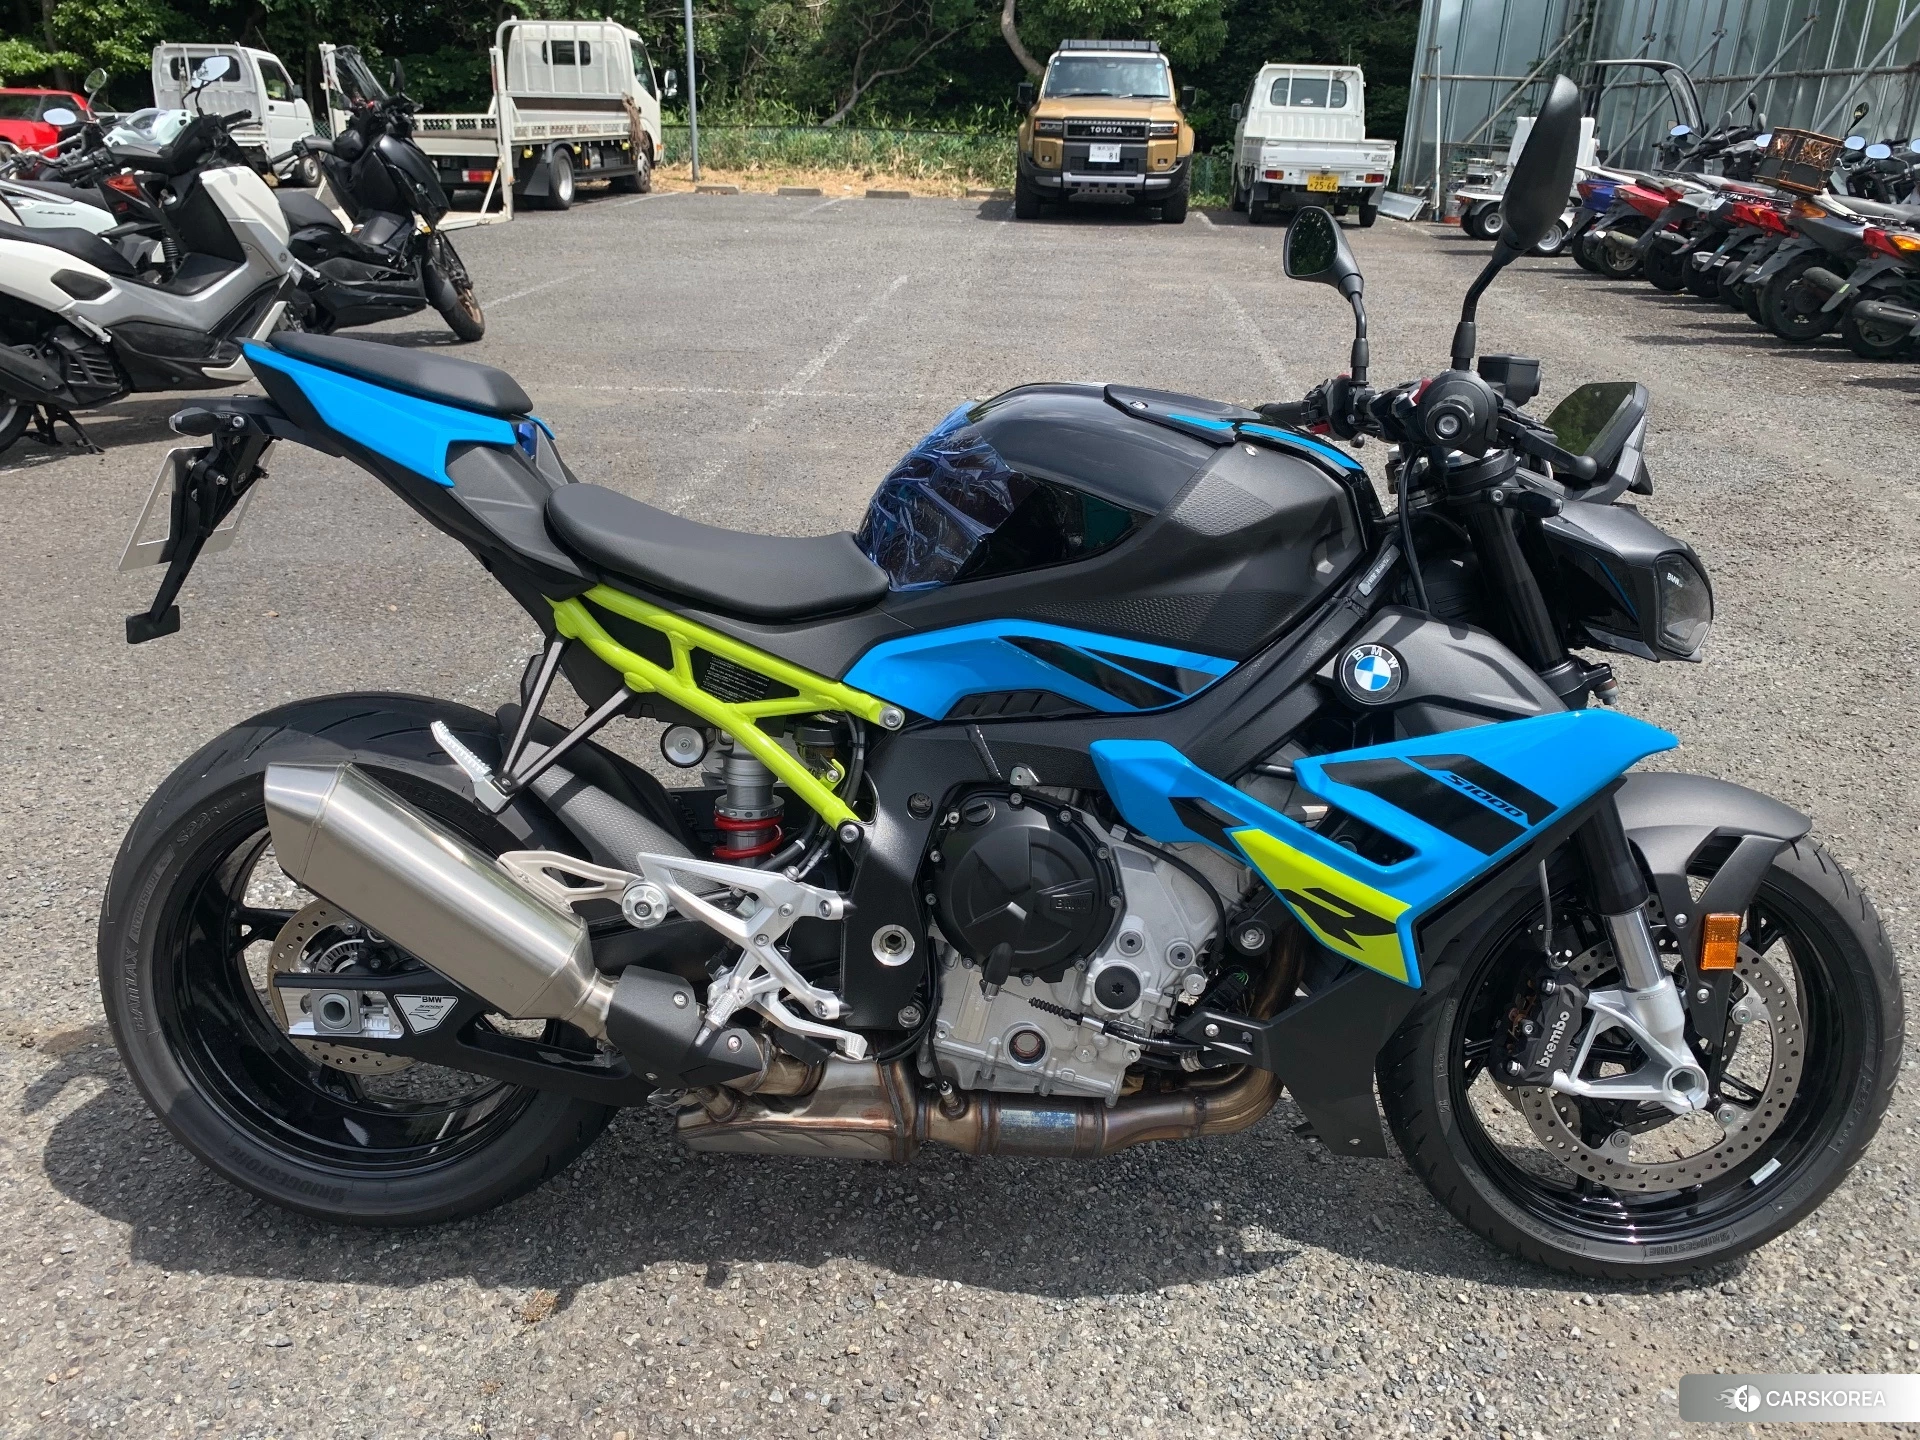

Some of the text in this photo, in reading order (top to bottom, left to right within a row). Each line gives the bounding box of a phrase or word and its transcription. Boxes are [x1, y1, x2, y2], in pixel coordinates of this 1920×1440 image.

[1090, 126, 1123, 134] TOYOTA
[1314, 181, 1336, 190] 25-66
[1666, 572, 1680, 586] BMW
[1352, 646, 1399, 669] BMW
[1442, 774, 1524, 818] S1000
[1536, 1010, 1570, 1068] brembo
[226, 1146, 349, 1204] BRIDGESTONE
[1649, 1231, 1731, 1256] BRIDGESTONE
